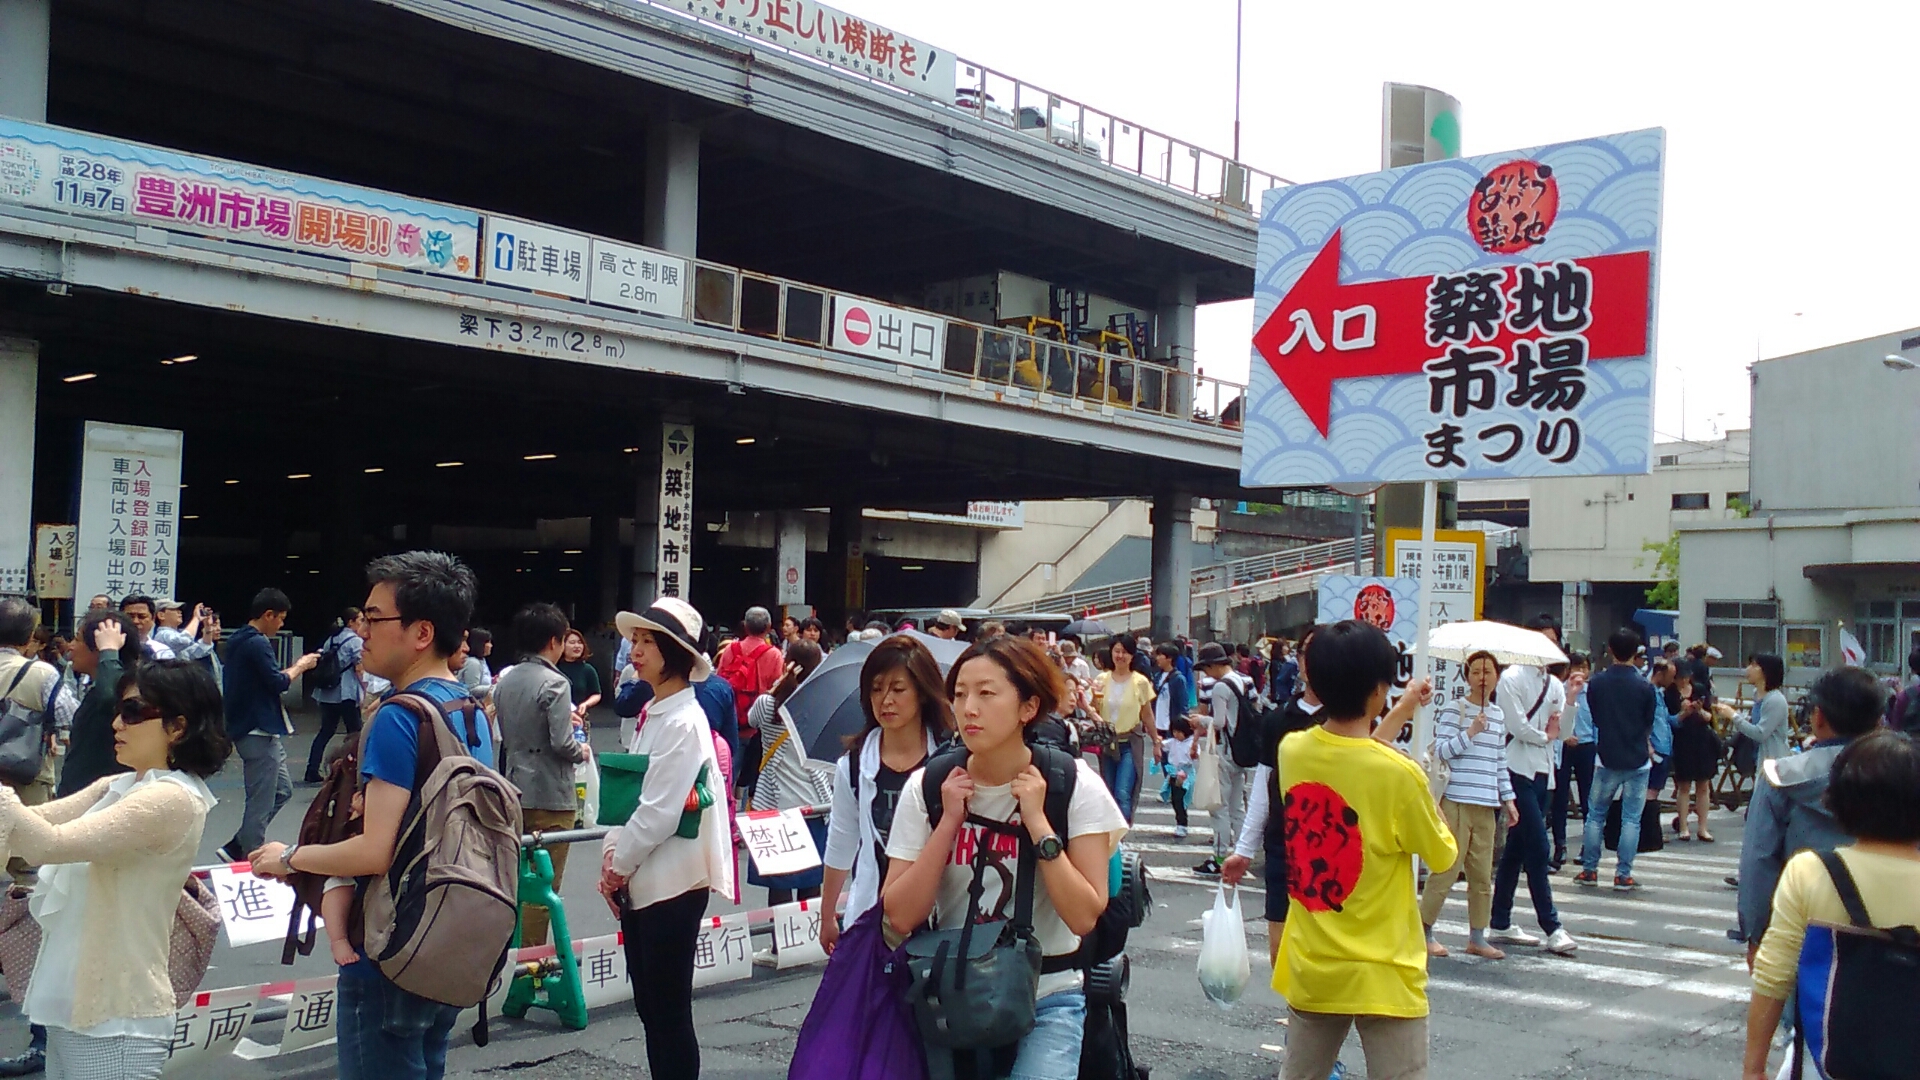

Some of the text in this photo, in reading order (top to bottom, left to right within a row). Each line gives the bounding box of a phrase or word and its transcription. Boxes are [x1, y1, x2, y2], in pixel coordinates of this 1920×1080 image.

[713, 0, 937, 82] り正しい横断を!
[62, 156, 122, 184] 平成28年
[1476, 165, 1552, 213] ありがとう
[54, 180, 125, 212] 11月7日
[1477, 210, 1546, 252] 築地
[517, 239, 581, 282] 駐車場
[599, 251, 678, 287] 高さ制限
[620, 282, 657, 304] 2.8m
[1427, 263, 1589, 344] 築地
[877, 313, 936, 361] 出口
[1279, 304, 1376, 355] 入口
[1427, 340, 1587, 418] 市場
[1424, 417, 1581, 468] まつり
[64, 531, 76, 577] タクシーは
[151, 501, 173, 600] 車両入場規
[661, 467, 683, 598] 築地市場
[1406, 552, 1467, 562] 規化時間
[746, 824, 806, 859] 禁止
[587, 948, 630, 988] 車
